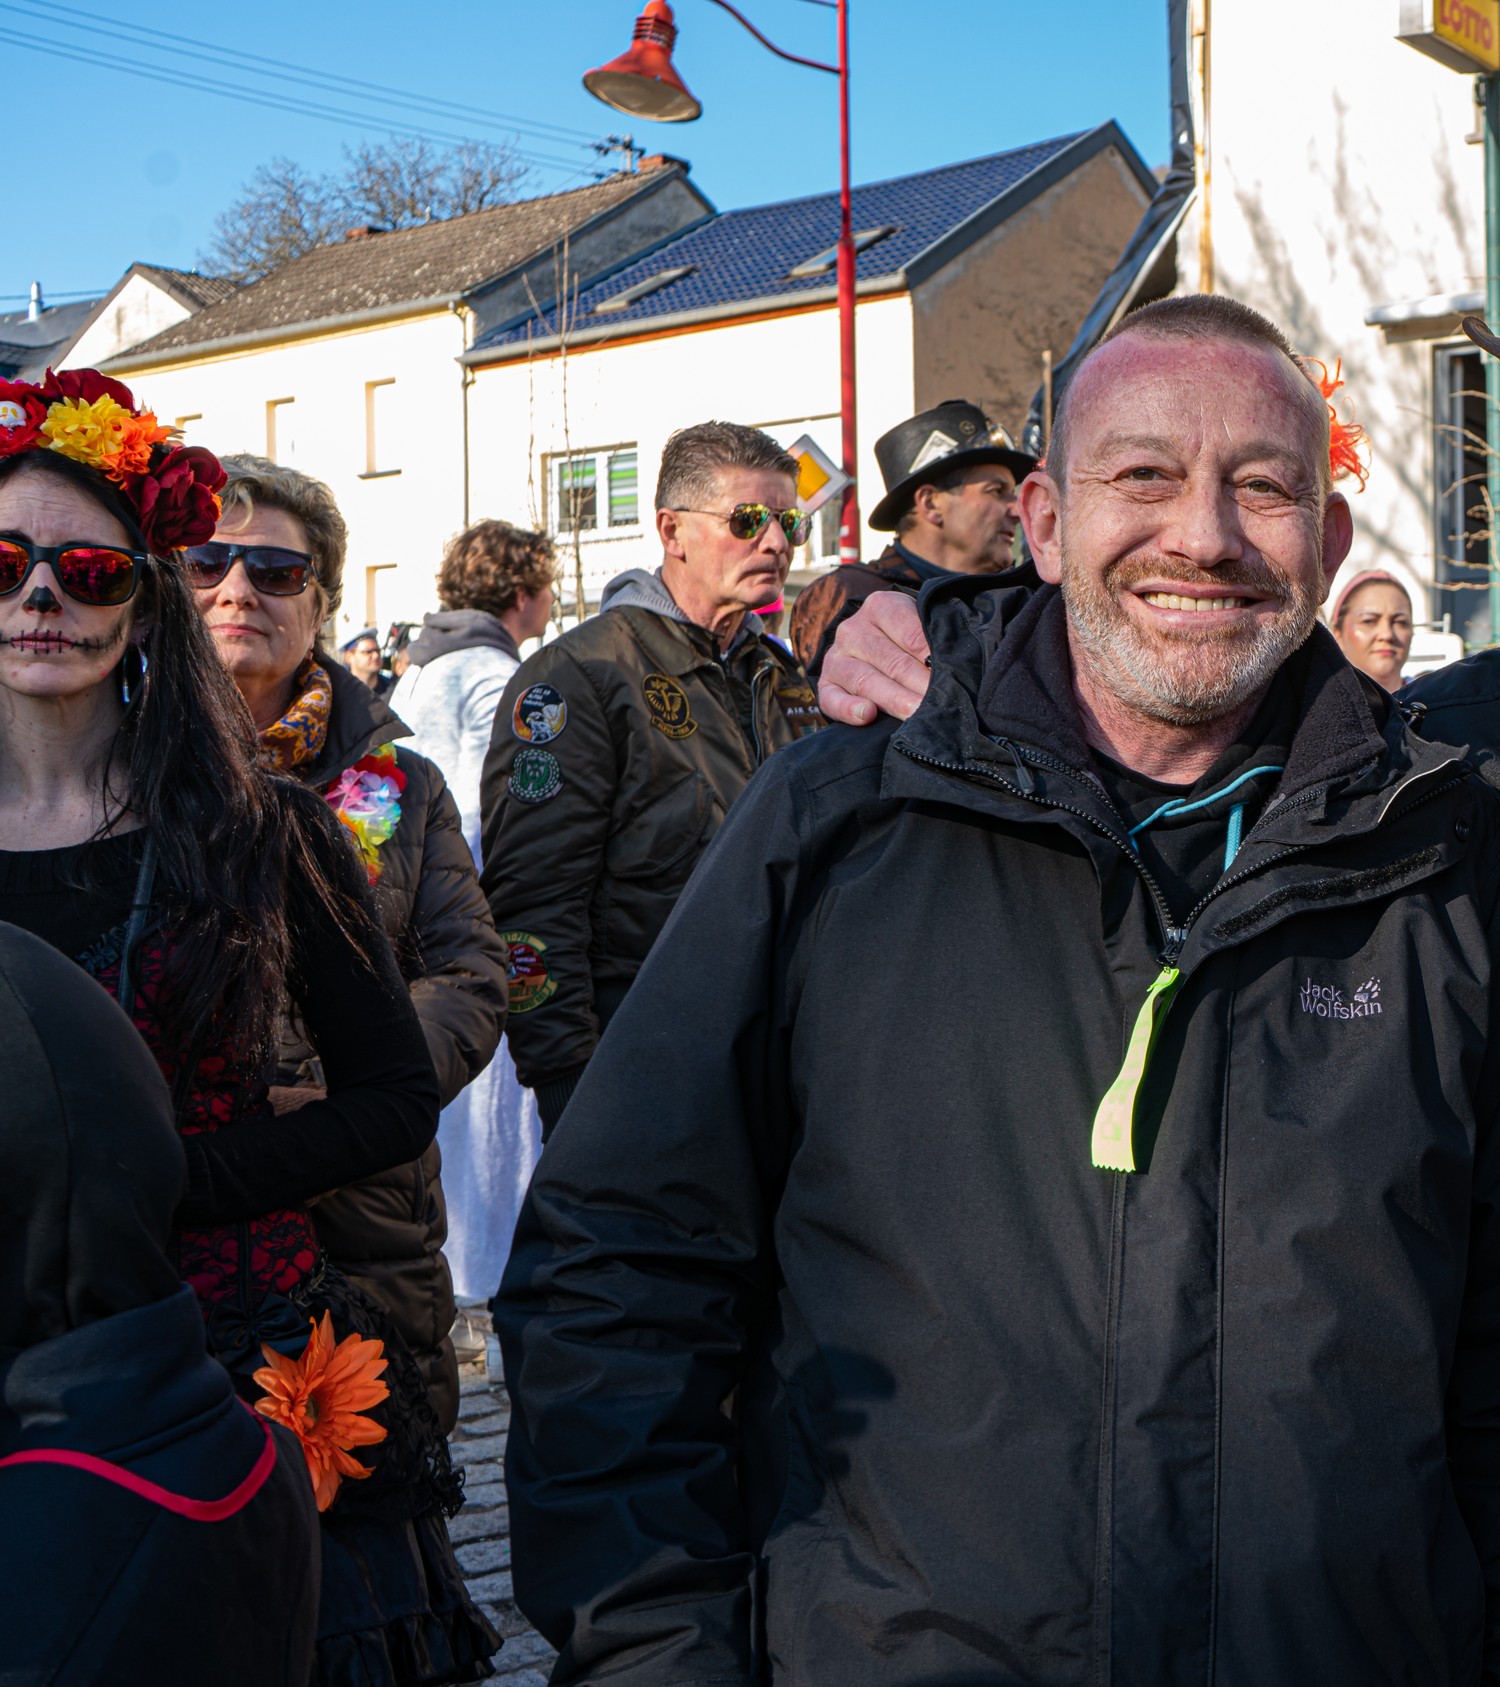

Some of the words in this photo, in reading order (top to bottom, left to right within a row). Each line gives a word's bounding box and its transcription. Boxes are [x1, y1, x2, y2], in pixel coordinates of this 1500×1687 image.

[1439, 0, 1493, 50] LOTTO
[1300, 977, 1344, 1002] Jack
[1300, 992, 1383, 1019] Wolfskin
